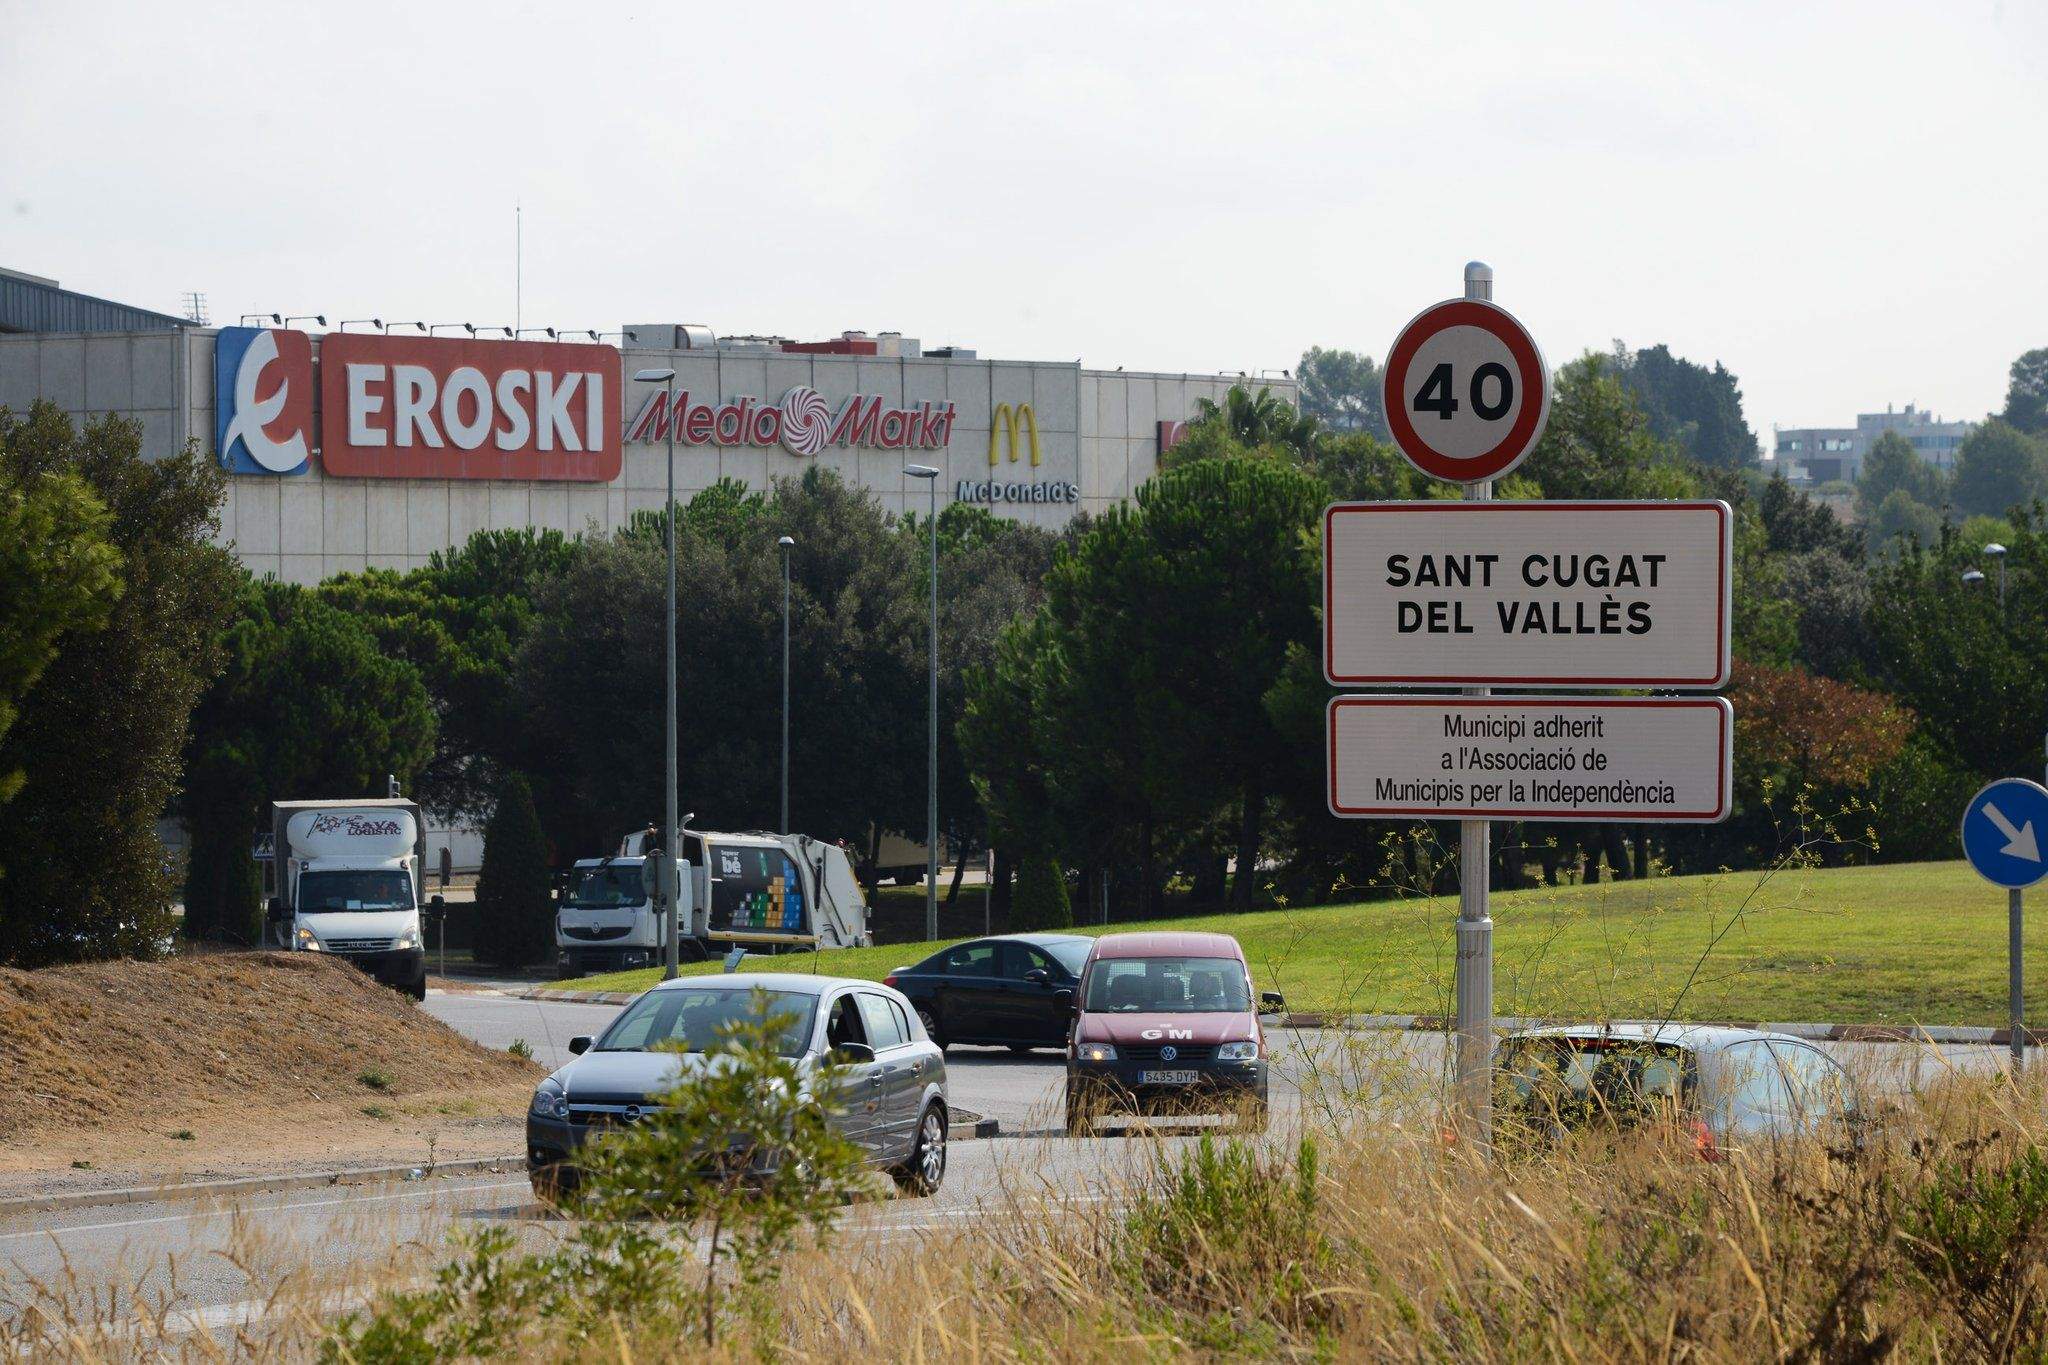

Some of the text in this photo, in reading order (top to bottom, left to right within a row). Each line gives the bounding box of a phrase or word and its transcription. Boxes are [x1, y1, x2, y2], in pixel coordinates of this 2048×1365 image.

[346, 363, 604, 452] EROSKI
[1413, 362, 1514, 421] 40
[623, 388, 957, 449] Media Markt
[957, 481, 1080, 504] McDonald's
[1385, 554, 1667, 588] SANT CUGAT
[1397, 594, 1653, 635] DEL VALLÈS
[1443, 714, 1604, 743] Municipi adherit
[1441, 746, 1608, 772] a l'Associació de
[1375, 778, 1676, 808] Municipis per la Independència
